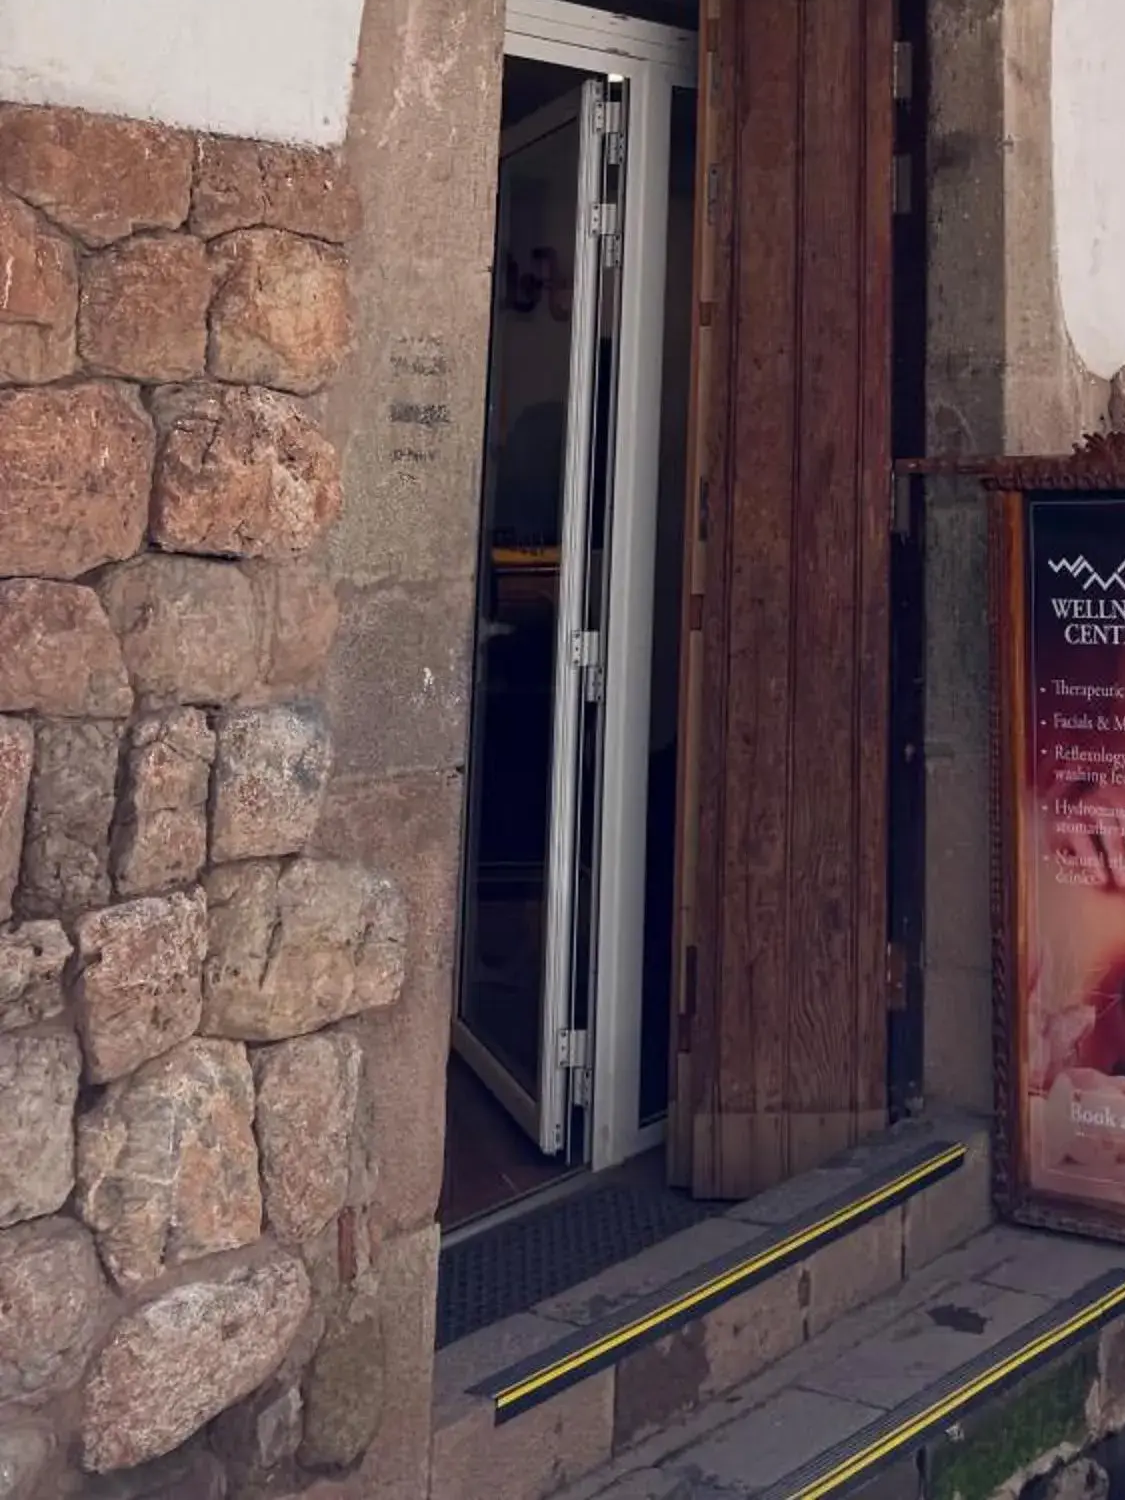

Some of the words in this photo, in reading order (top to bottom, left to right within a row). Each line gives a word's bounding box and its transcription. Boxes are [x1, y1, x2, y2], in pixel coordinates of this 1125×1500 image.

[1051, 678, 1124, 700] Therapeutic
[1053, 712, 1093, 730] Facials
[1097, 715, 1110, 731] &
[1054, 766, 1108, 786] washing
[1070, 1102, 1116, 1128] Book
